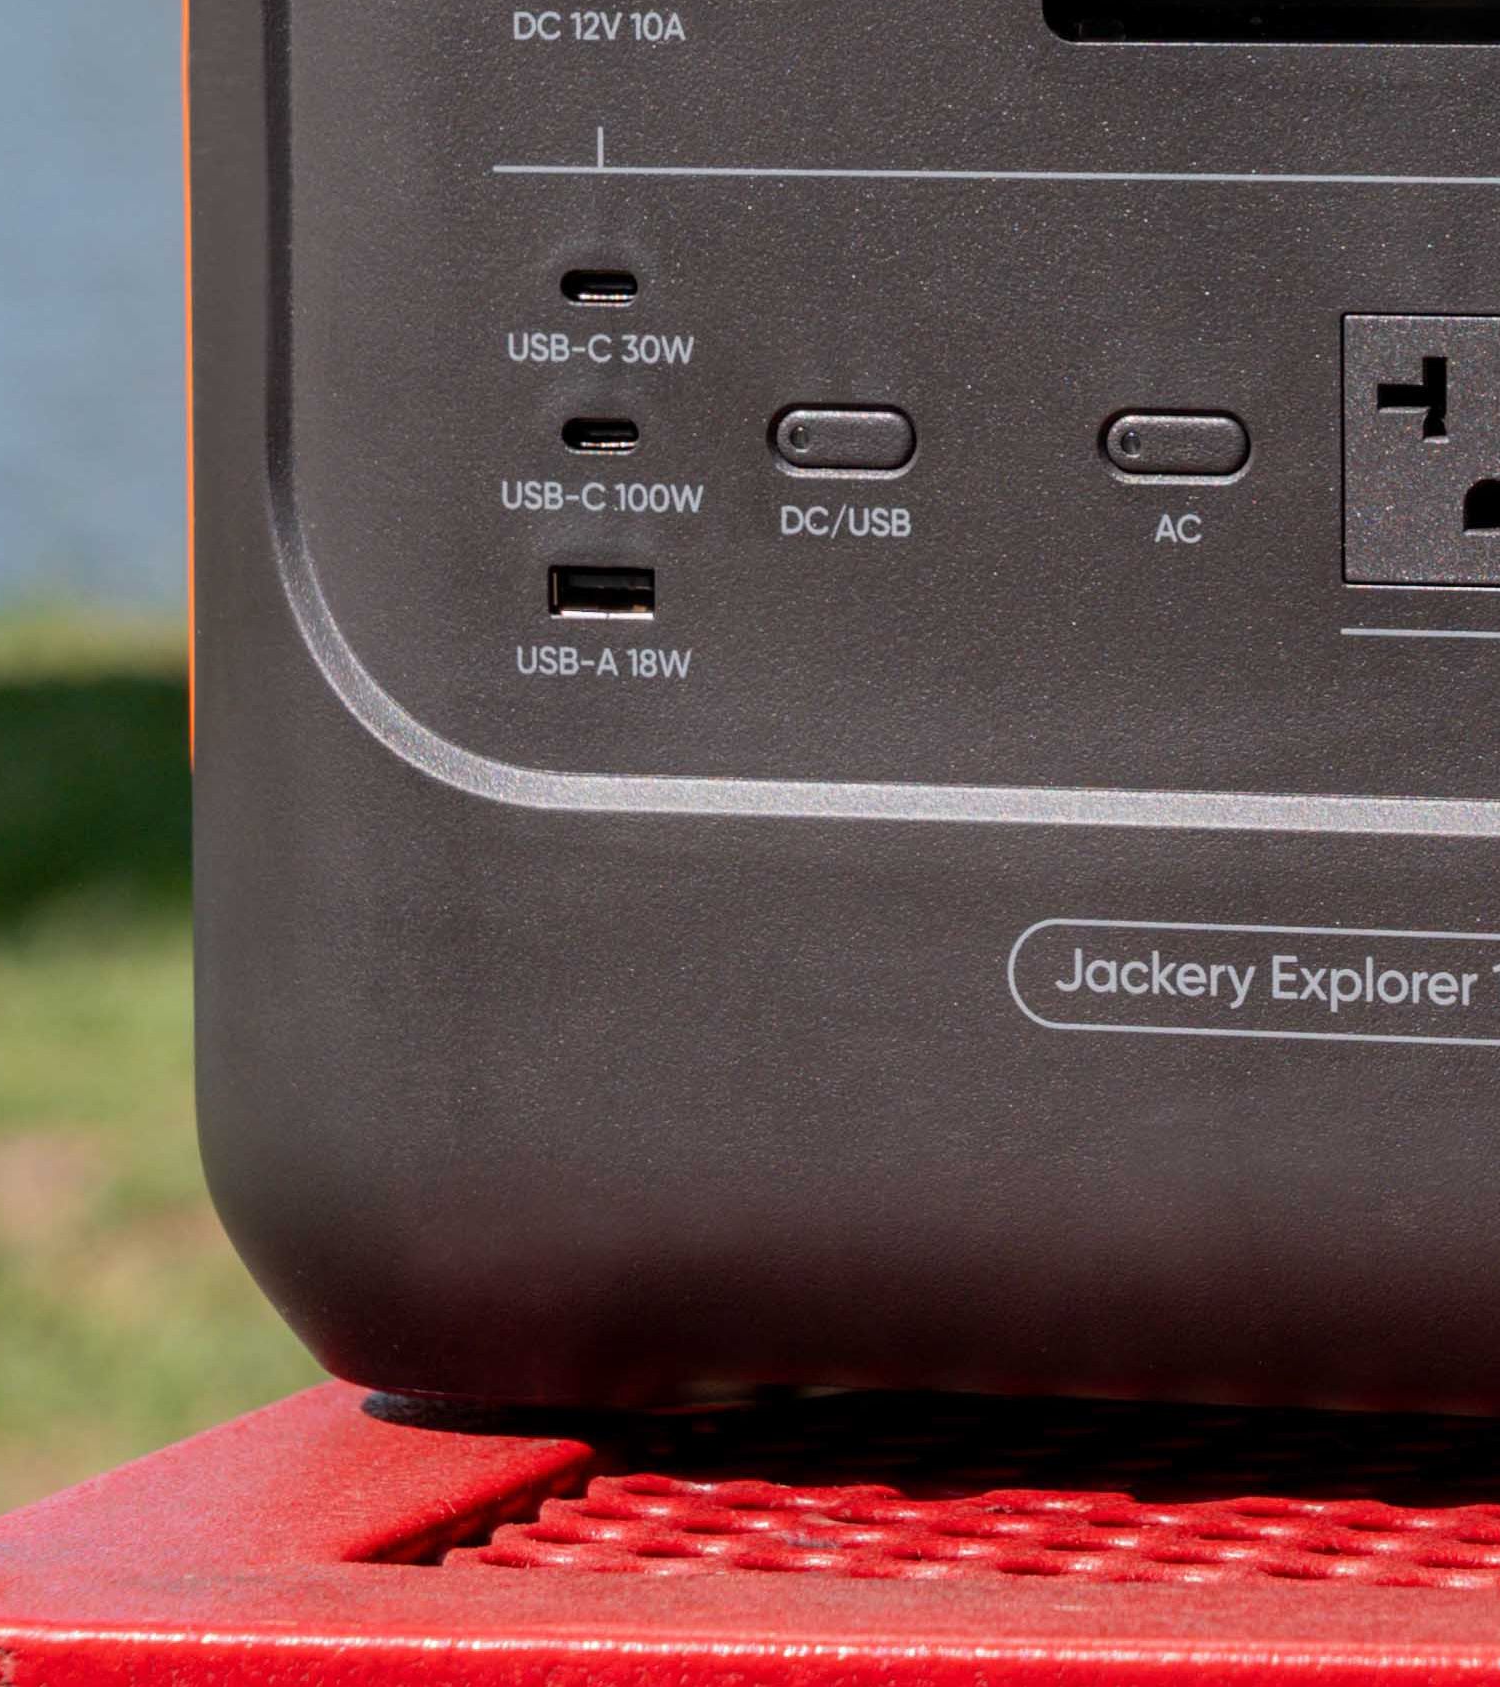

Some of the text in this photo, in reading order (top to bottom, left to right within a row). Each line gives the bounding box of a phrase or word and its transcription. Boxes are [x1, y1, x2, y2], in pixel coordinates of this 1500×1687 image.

[512, 10, 687, 43] DC 12V 10A
[507, 331, 696, 366] USB-C 30W
[501, 480, 705, 514] USB-C 100W
[779, 503, 913, 539] DC/USB
[1153, 512, 1203, 545] AC
[515, 645, 693, 680] USB-A 18W
[1054, 946, 1257, 1010] Jackery
[1270, 953, 1480, 1014] Explorer
